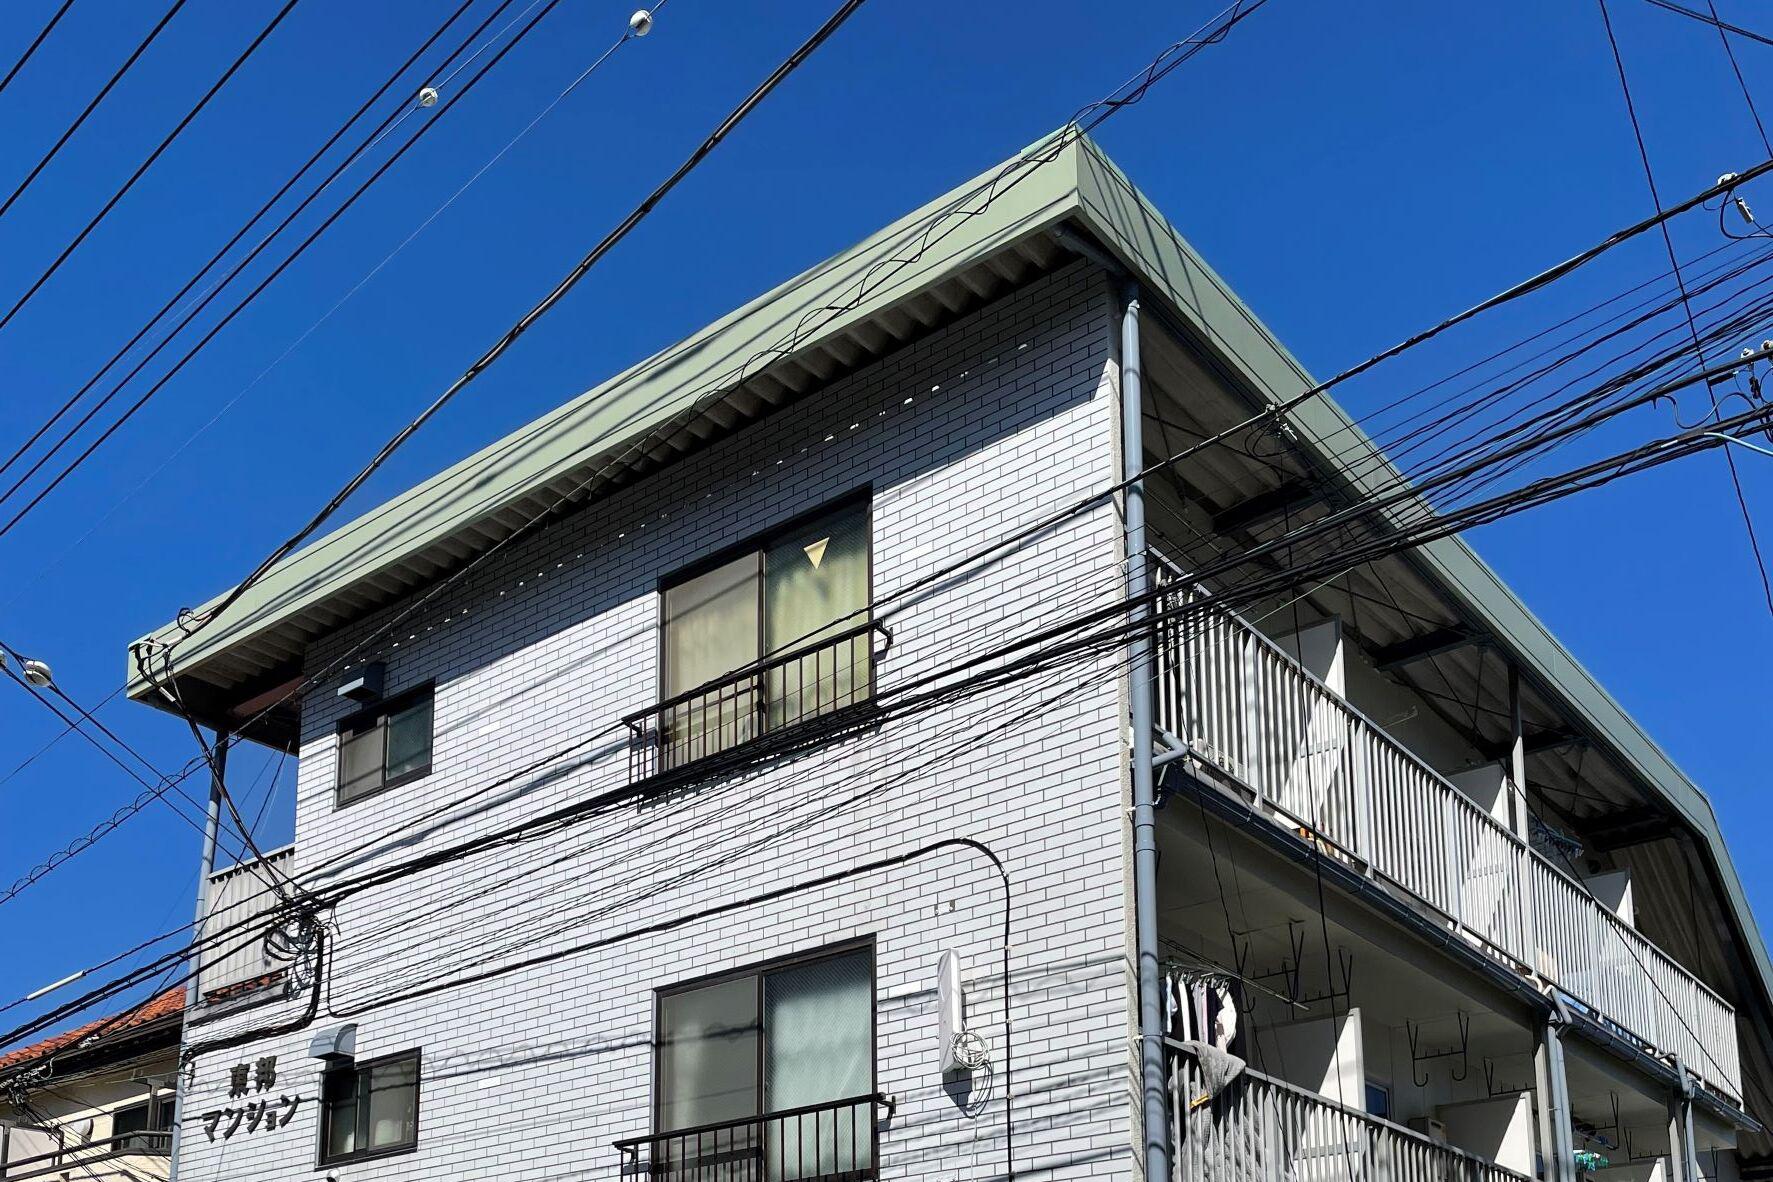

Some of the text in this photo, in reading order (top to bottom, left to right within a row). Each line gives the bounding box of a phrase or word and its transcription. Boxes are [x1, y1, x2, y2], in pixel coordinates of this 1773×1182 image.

[201, 1094, 300, 1144] マンション
